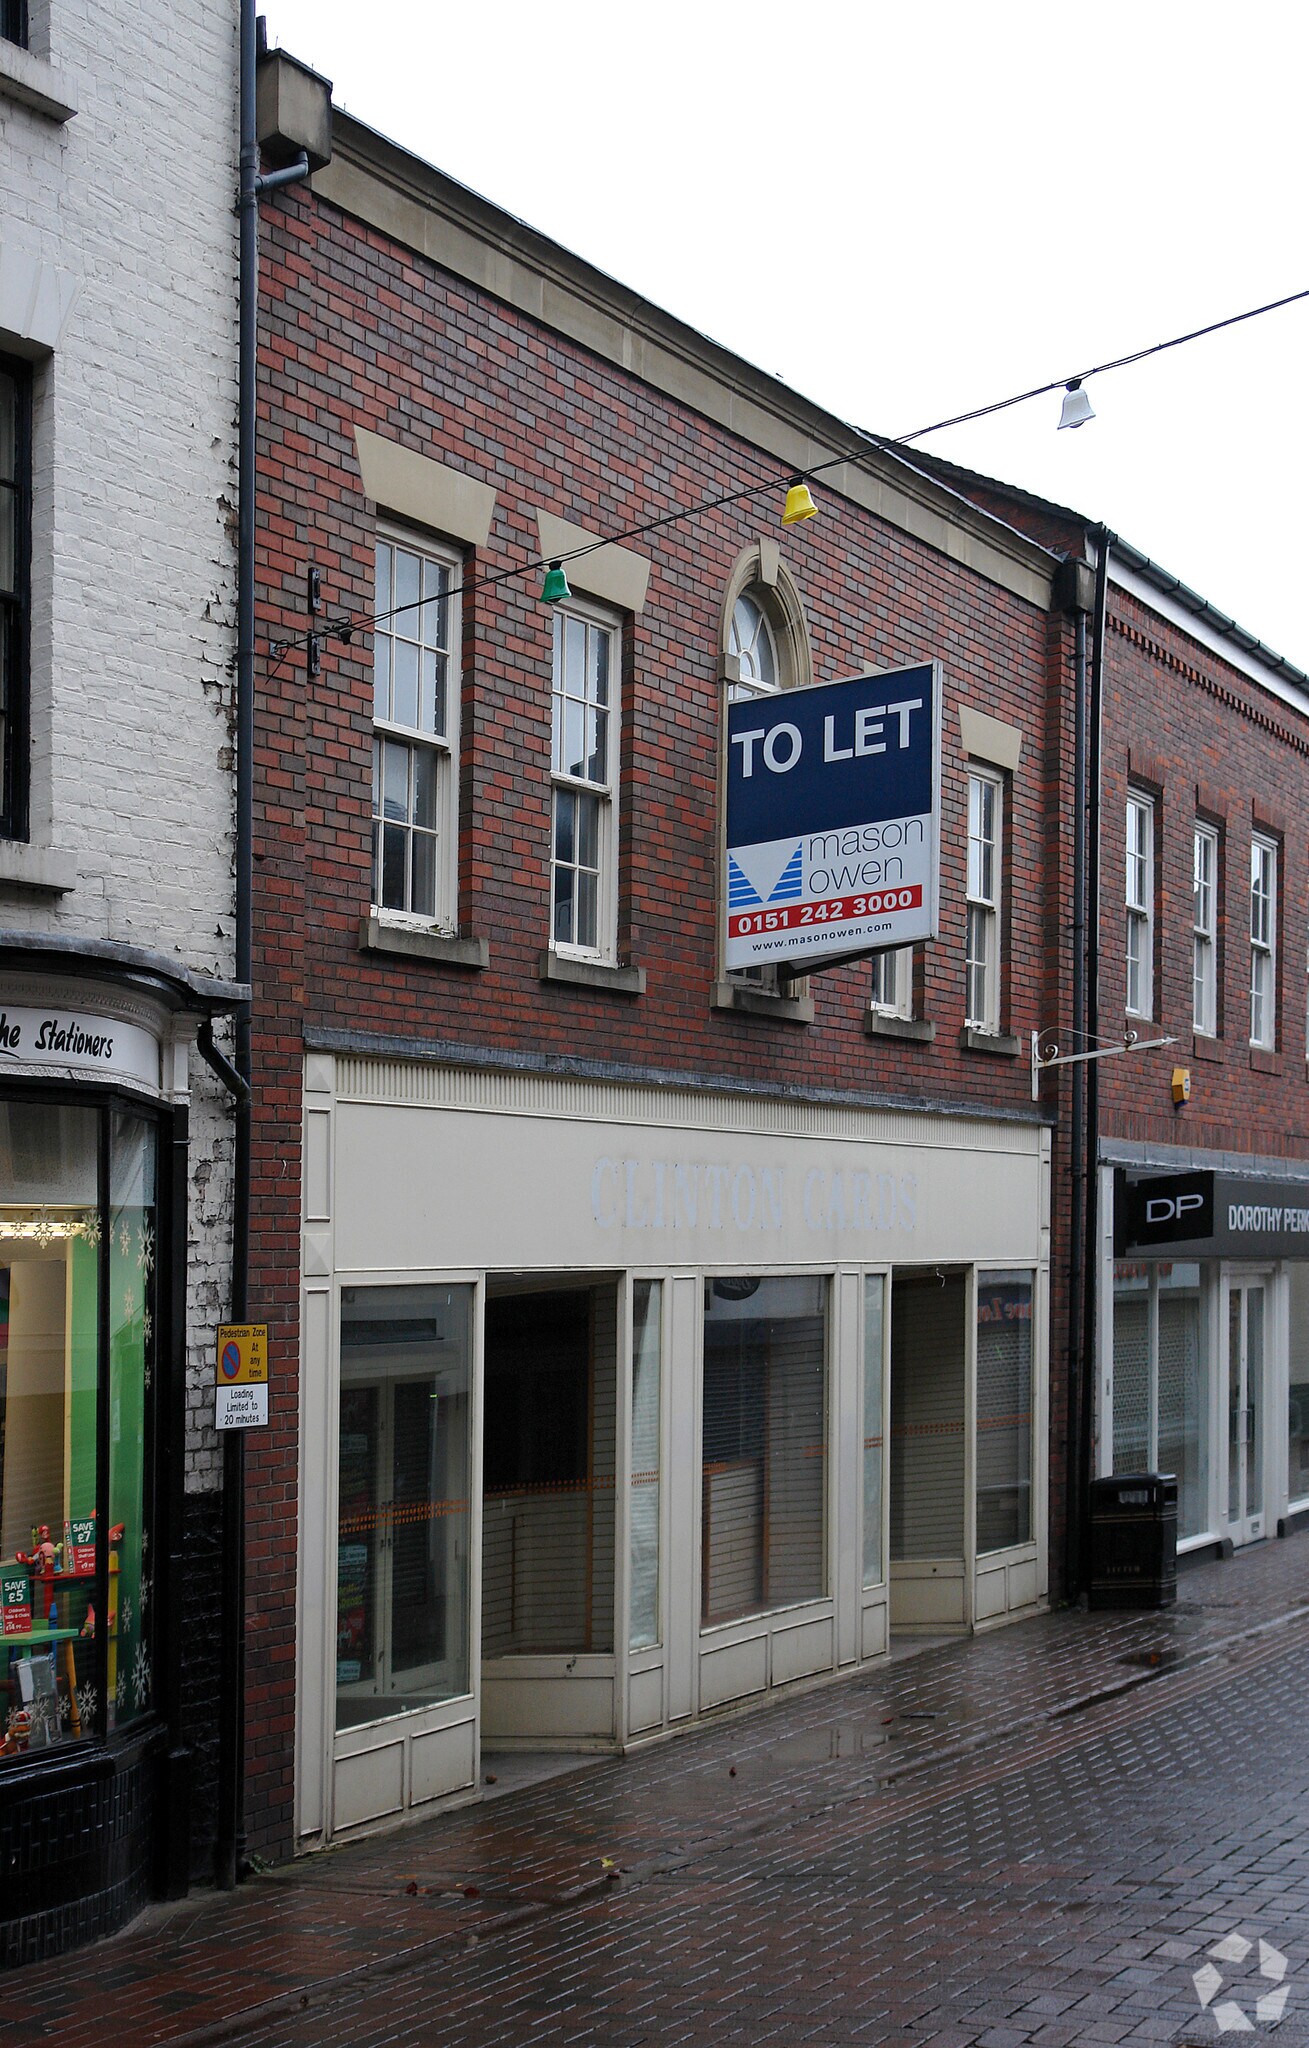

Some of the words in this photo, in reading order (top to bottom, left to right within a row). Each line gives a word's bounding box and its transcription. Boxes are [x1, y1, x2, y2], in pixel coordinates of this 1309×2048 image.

[731, 722, 803, 778] TO
[824, 698, 923, 763] LET
[809, 819, 923, 861] mason
[809, 855, 903, 894] owen
[738, 910, 789, 934] 0151
[800, 901, 843, 924] 242
[853, 890, 912, 915] 3000
[752, 922, 892, 951] www.masonowen.com
[35, 1019, 114, 1058] Stationers
[591, 1156, 785, 1232] CLINTON
[803, 1167, 918, 1233] CARDS
[1146, 1194, 1204, 1223] DP
[1228, 1205, 1283, 1232] DOROTHY
[220, 1328, 250, 1338] Pedestrian
[252, 1327, 266, 1337] Zone
[251, 1343, 259, 1352] At
[250, 1356, 261, 1367] any
[249, 1369, 262, 1378] time
[230, 1389, 254, 1400] Loading
[226, 1402, 249, 1413] Limited
[251, 1402, 258, 1410] to
[224, 1415, 233, 1425] 20
[235, 1413, 260, 1424] minutes
[72, 1521, 94, 1533] SAVE
[77, 1531, 91, 1543] £7
[4, 1580, 26, 1591] SAVE
[8, 1590, 24, 1602] £5
